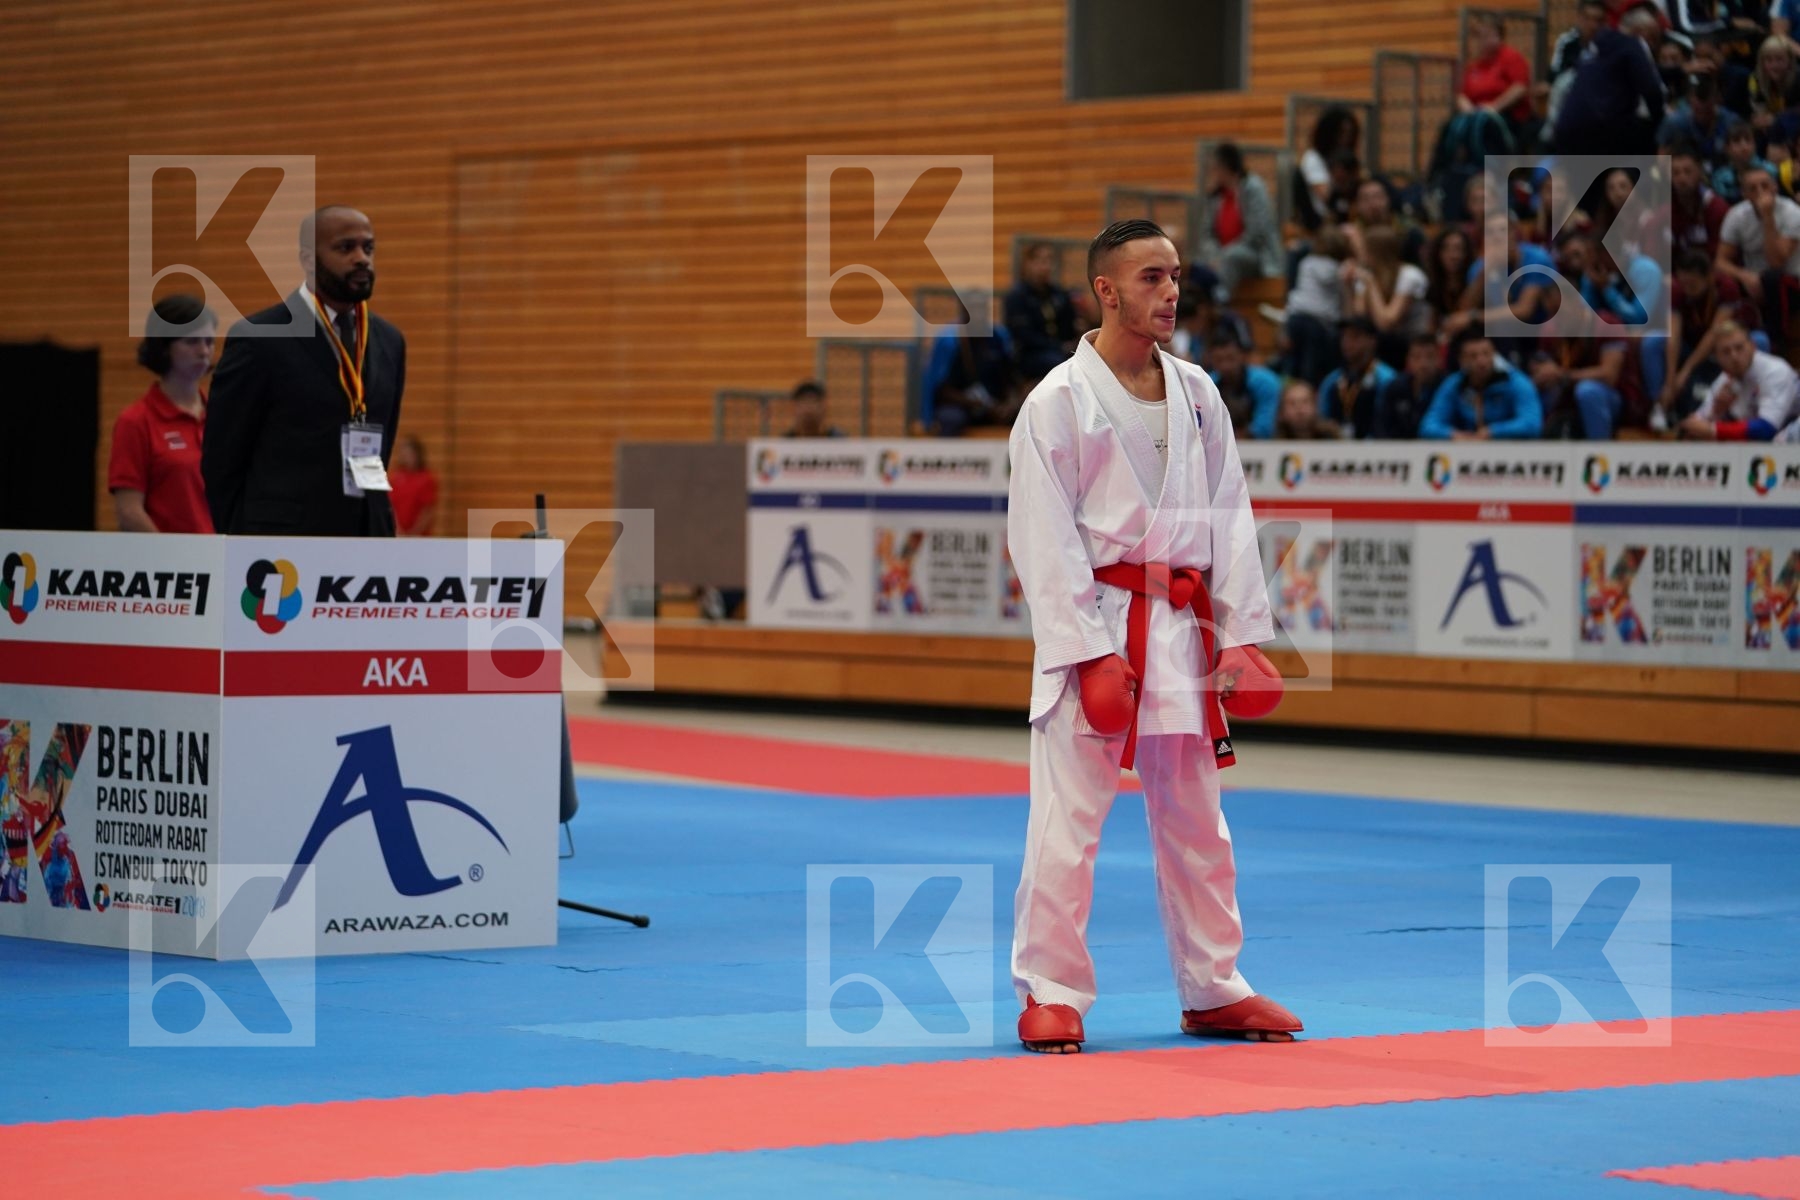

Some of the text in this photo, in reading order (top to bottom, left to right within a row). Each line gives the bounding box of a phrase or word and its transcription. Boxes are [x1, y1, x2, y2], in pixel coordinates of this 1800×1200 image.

[1653, 546, 1731, 576] BERLIN
[45, 598, 190, 616] PREMIER LEAGUE
[47, 569, 210, 616] KARATE1
[315, 575, 548, 619] KARATE1
[312, 606, 520, 619] PREMIER LEAGUE
[362, 657, 429, 687] AKA
[97, 725, 210, 787] BERLIN
[97, 786, 208, 820] PARIS DUBAI
[96, 820, 208, 853] ROTTERDAM RABAT
[94, 852, 208, 887] ISTANBUL TOKYO
[112, 891, 182, 915] KARATE1
[324, 911, 510, 934] ARAWAZA.COM
